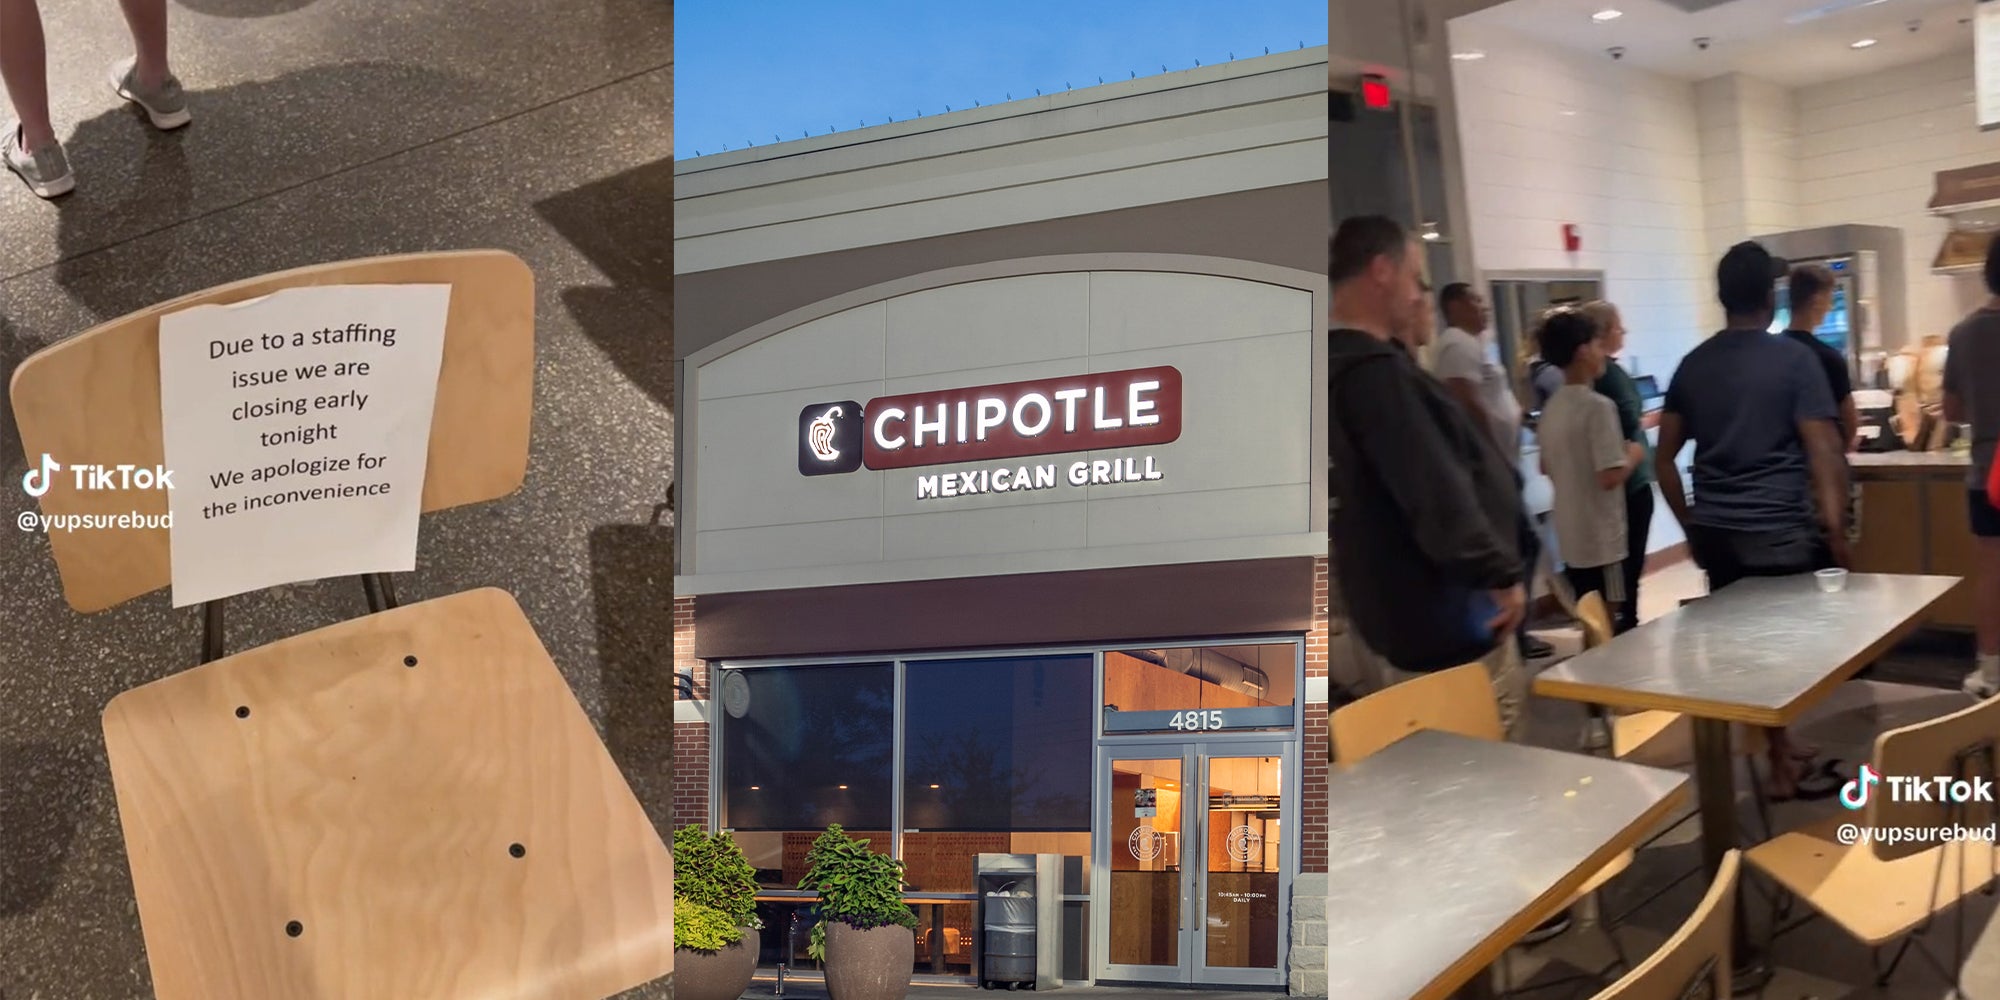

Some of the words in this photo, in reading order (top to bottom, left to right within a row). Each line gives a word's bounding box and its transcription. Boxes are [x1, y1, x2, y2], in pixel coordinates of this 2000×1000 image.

[209, 338, 254, 360] Due
[260, 332, 285, 350] to
[291, 332, 304, 347] a
[311, 322, 397, 347] staffing
[232, 368, 288, 389] issue
[294, 364, 328, 380] we
[334, 361, 370, 377] are
[231, 397, 308, 421] closing
[313, 389, 369, 411] early
[873, 379, 1160, 451] CHIPOTLE
[260, 422, 338, 447] tonight
[209, 470, 245, 489] We
[250, 456, 351, 483] apologize
[356, 452, 387, 470] for
[917, 464, 1057, 500] MEXICAN
[1068, 455, 1163, 486] GRILL
[202, 502, 238, 520] the
[244, 482, 391, 511] inconvenience
[1169, 710, 1223, 730] 4815
